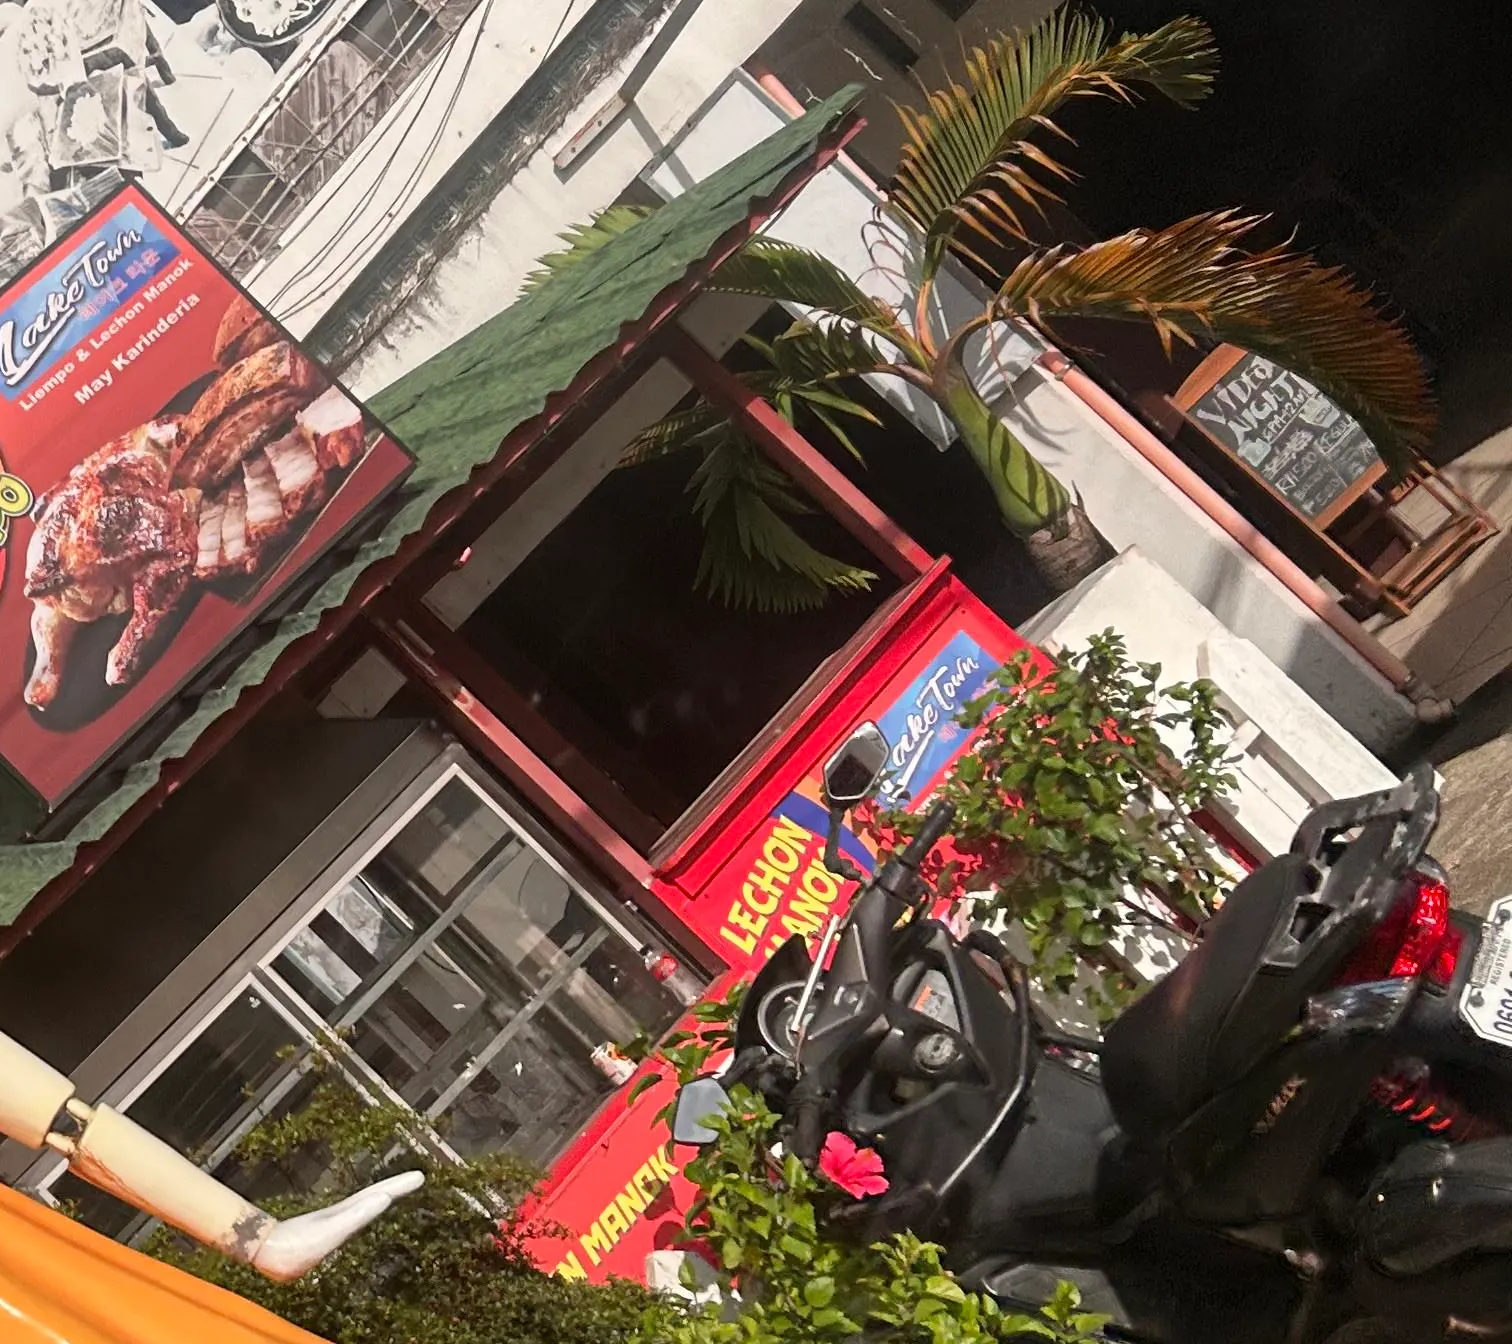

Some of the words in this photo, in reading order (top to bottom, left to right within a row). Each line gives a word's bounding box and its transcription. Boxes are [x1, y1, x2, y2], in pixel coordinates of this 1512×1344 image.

[62, 229, 142, 288] Town
[19, 362, 76, 411] Liempo
[75, 348, 91, 362] &
[89, 301, 145, 350] Lechon
[142, 258, 194, 302] Manok
[74, 368, 114, 405] May
[111, 293, 201, 372] Karinderia
[916, 655, 981, 712] Town
[720, 814, 813, 956] LECHON
[579, 1144, 679, 1266] MANOK
